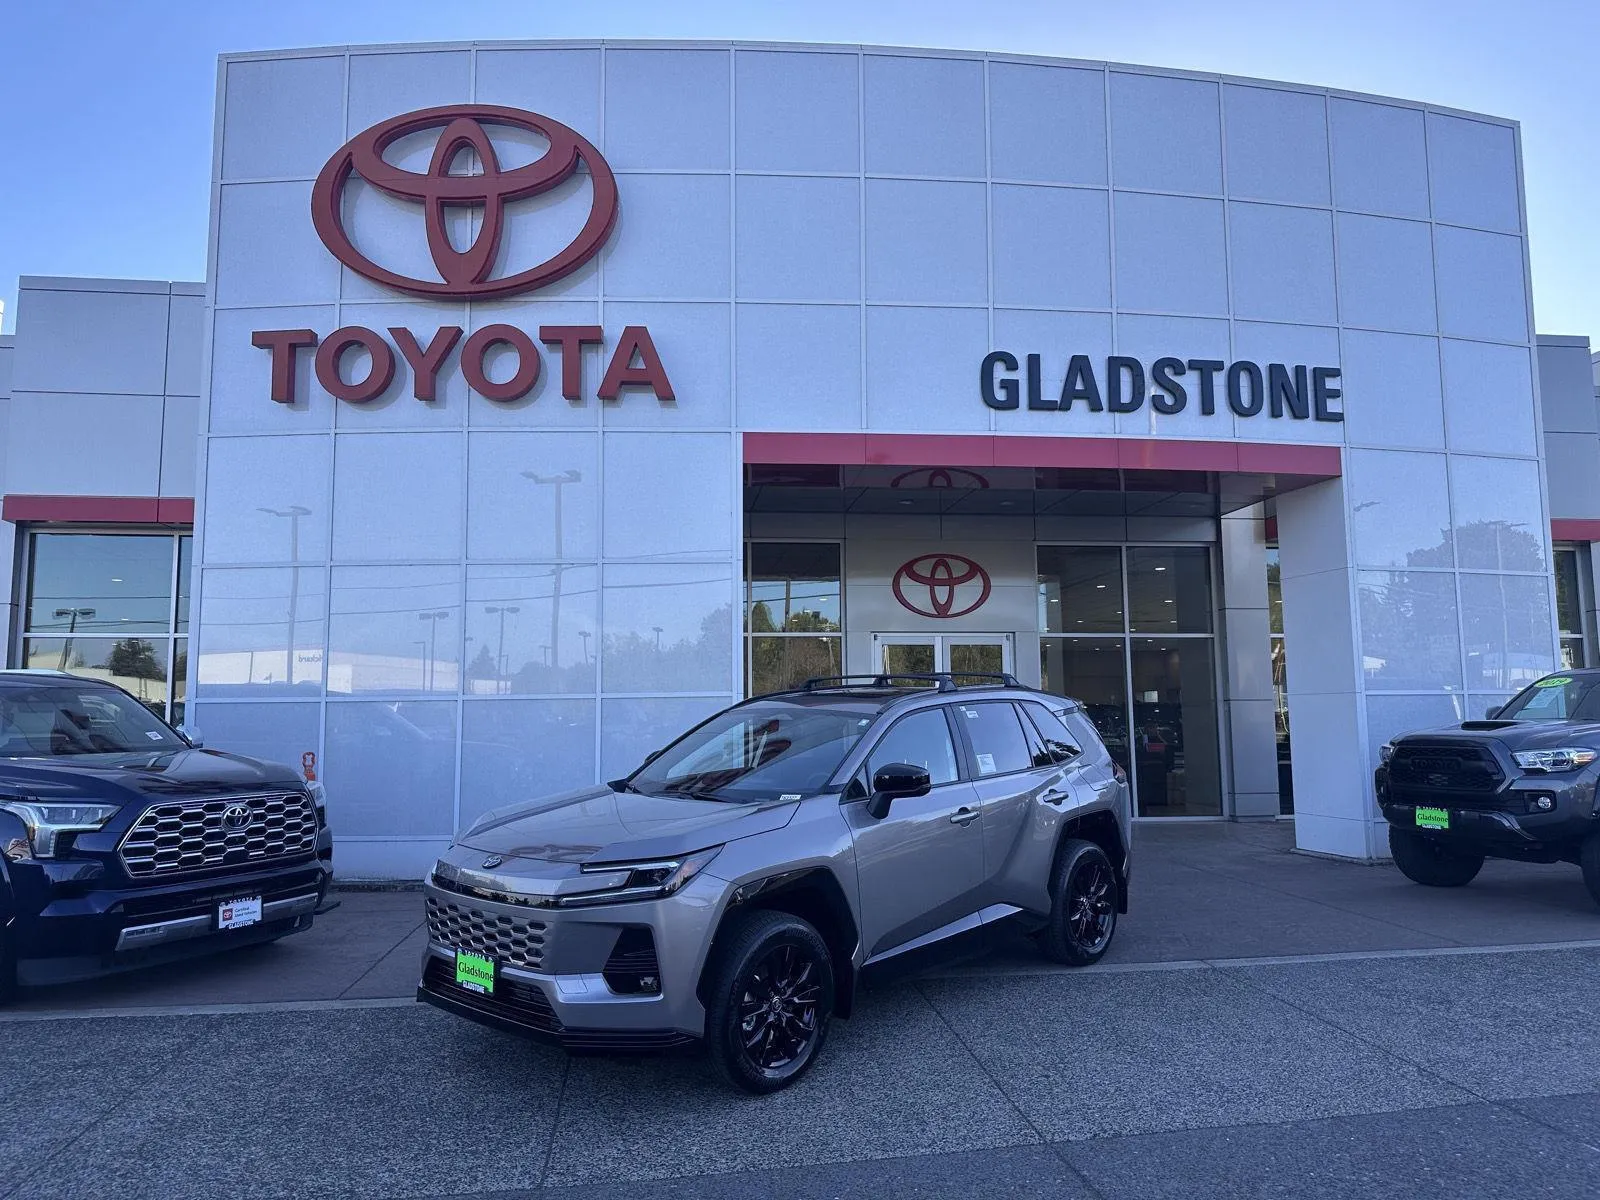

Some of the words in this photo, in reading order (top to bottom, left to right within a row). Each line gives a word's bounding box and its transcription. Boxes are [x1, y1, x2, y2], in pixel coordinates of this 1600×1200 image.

[252, 324, 676, 404] TOYOTA
[980, 351, 1344, 422] GLADSTONE
[1417, 813, 1449, 823] Gladstone
[229, 920, 254, 929] GLADSTONE
[458, 962, 494, 982] Gladstone
